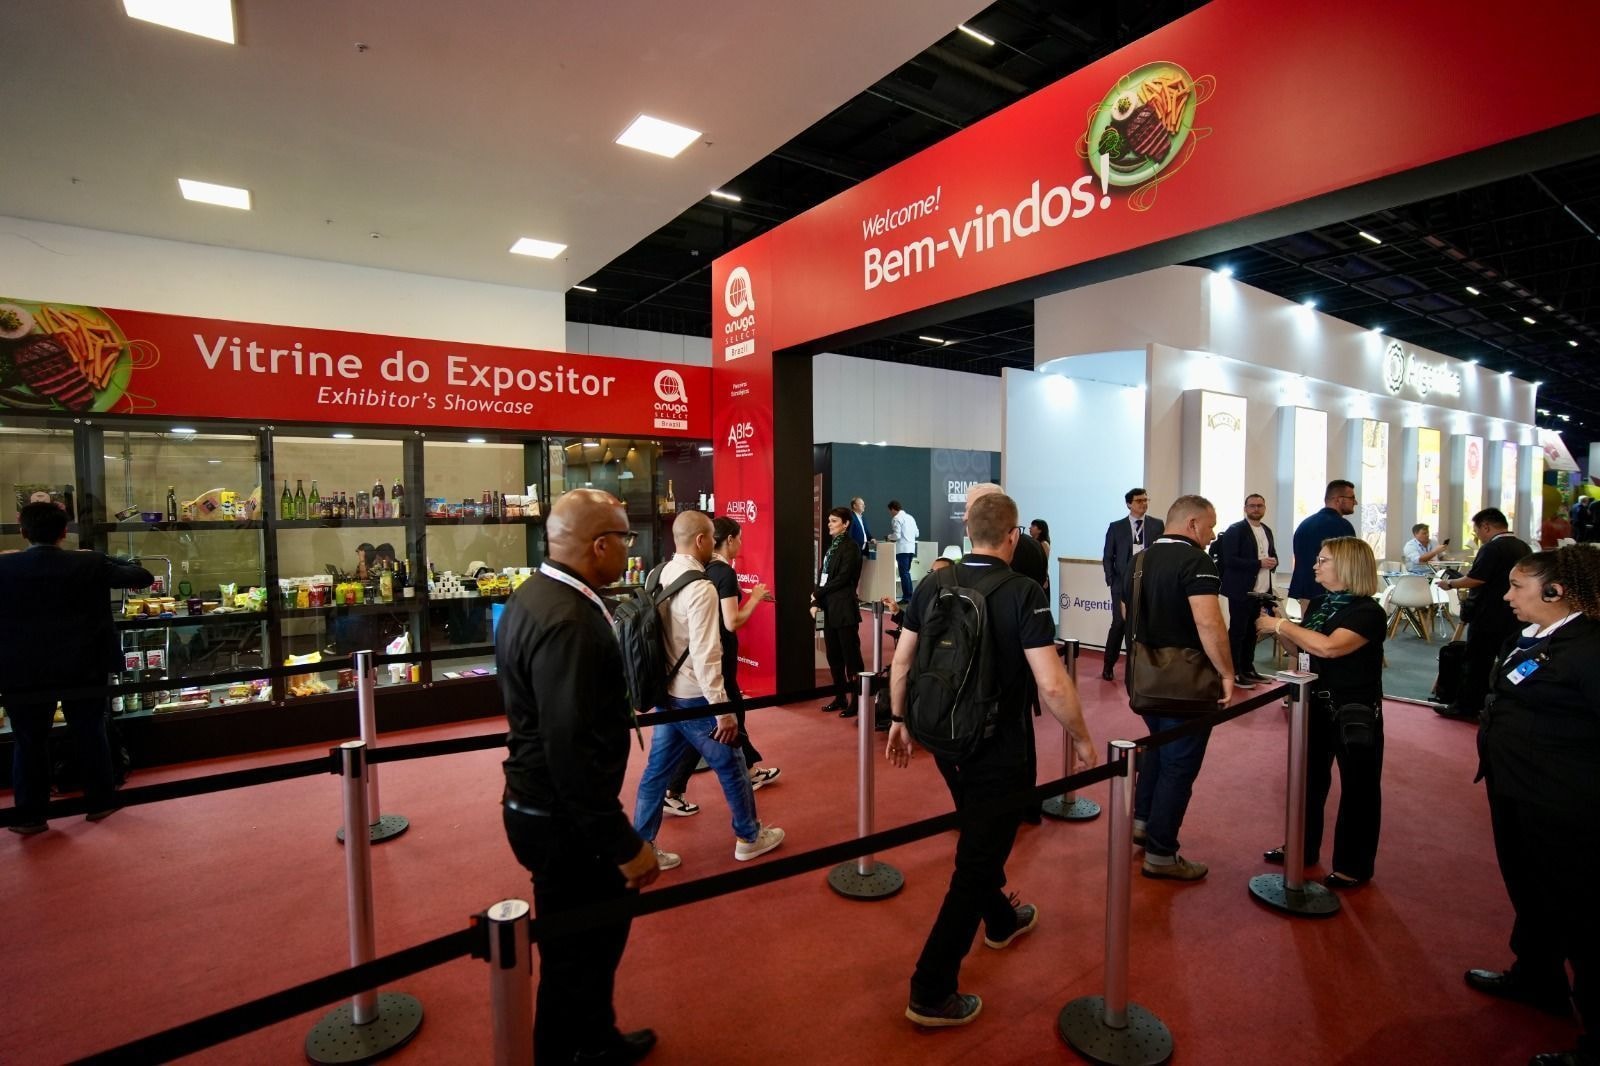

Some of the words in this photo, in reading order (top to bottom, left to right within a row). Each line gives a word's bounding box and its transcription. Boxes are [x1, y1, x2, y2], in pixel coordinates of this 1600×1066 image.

[862, 185, 942, 240] Welcome!
[864, 153, 1112, 291] Bem-vindos!
[725, 315, 755, 334] anuga
[725, 328, 756, 345] SELECT
[193, 334, 363, 379] Vitrine
[380, 351, 430, 383] do
[447, 355, 616, 397] Expositor
[1406, 353, 1461, 397] Argea
[444, 393, 534, 415] Showcase
[654, 402, 688, 414] anuga
[654, 411, 688, 419] SELECT
[661, 420, 681, 428] Brazil
[726, 501, 746, 513] ABIR
[1073, 597, 1113, 611] Argenti
